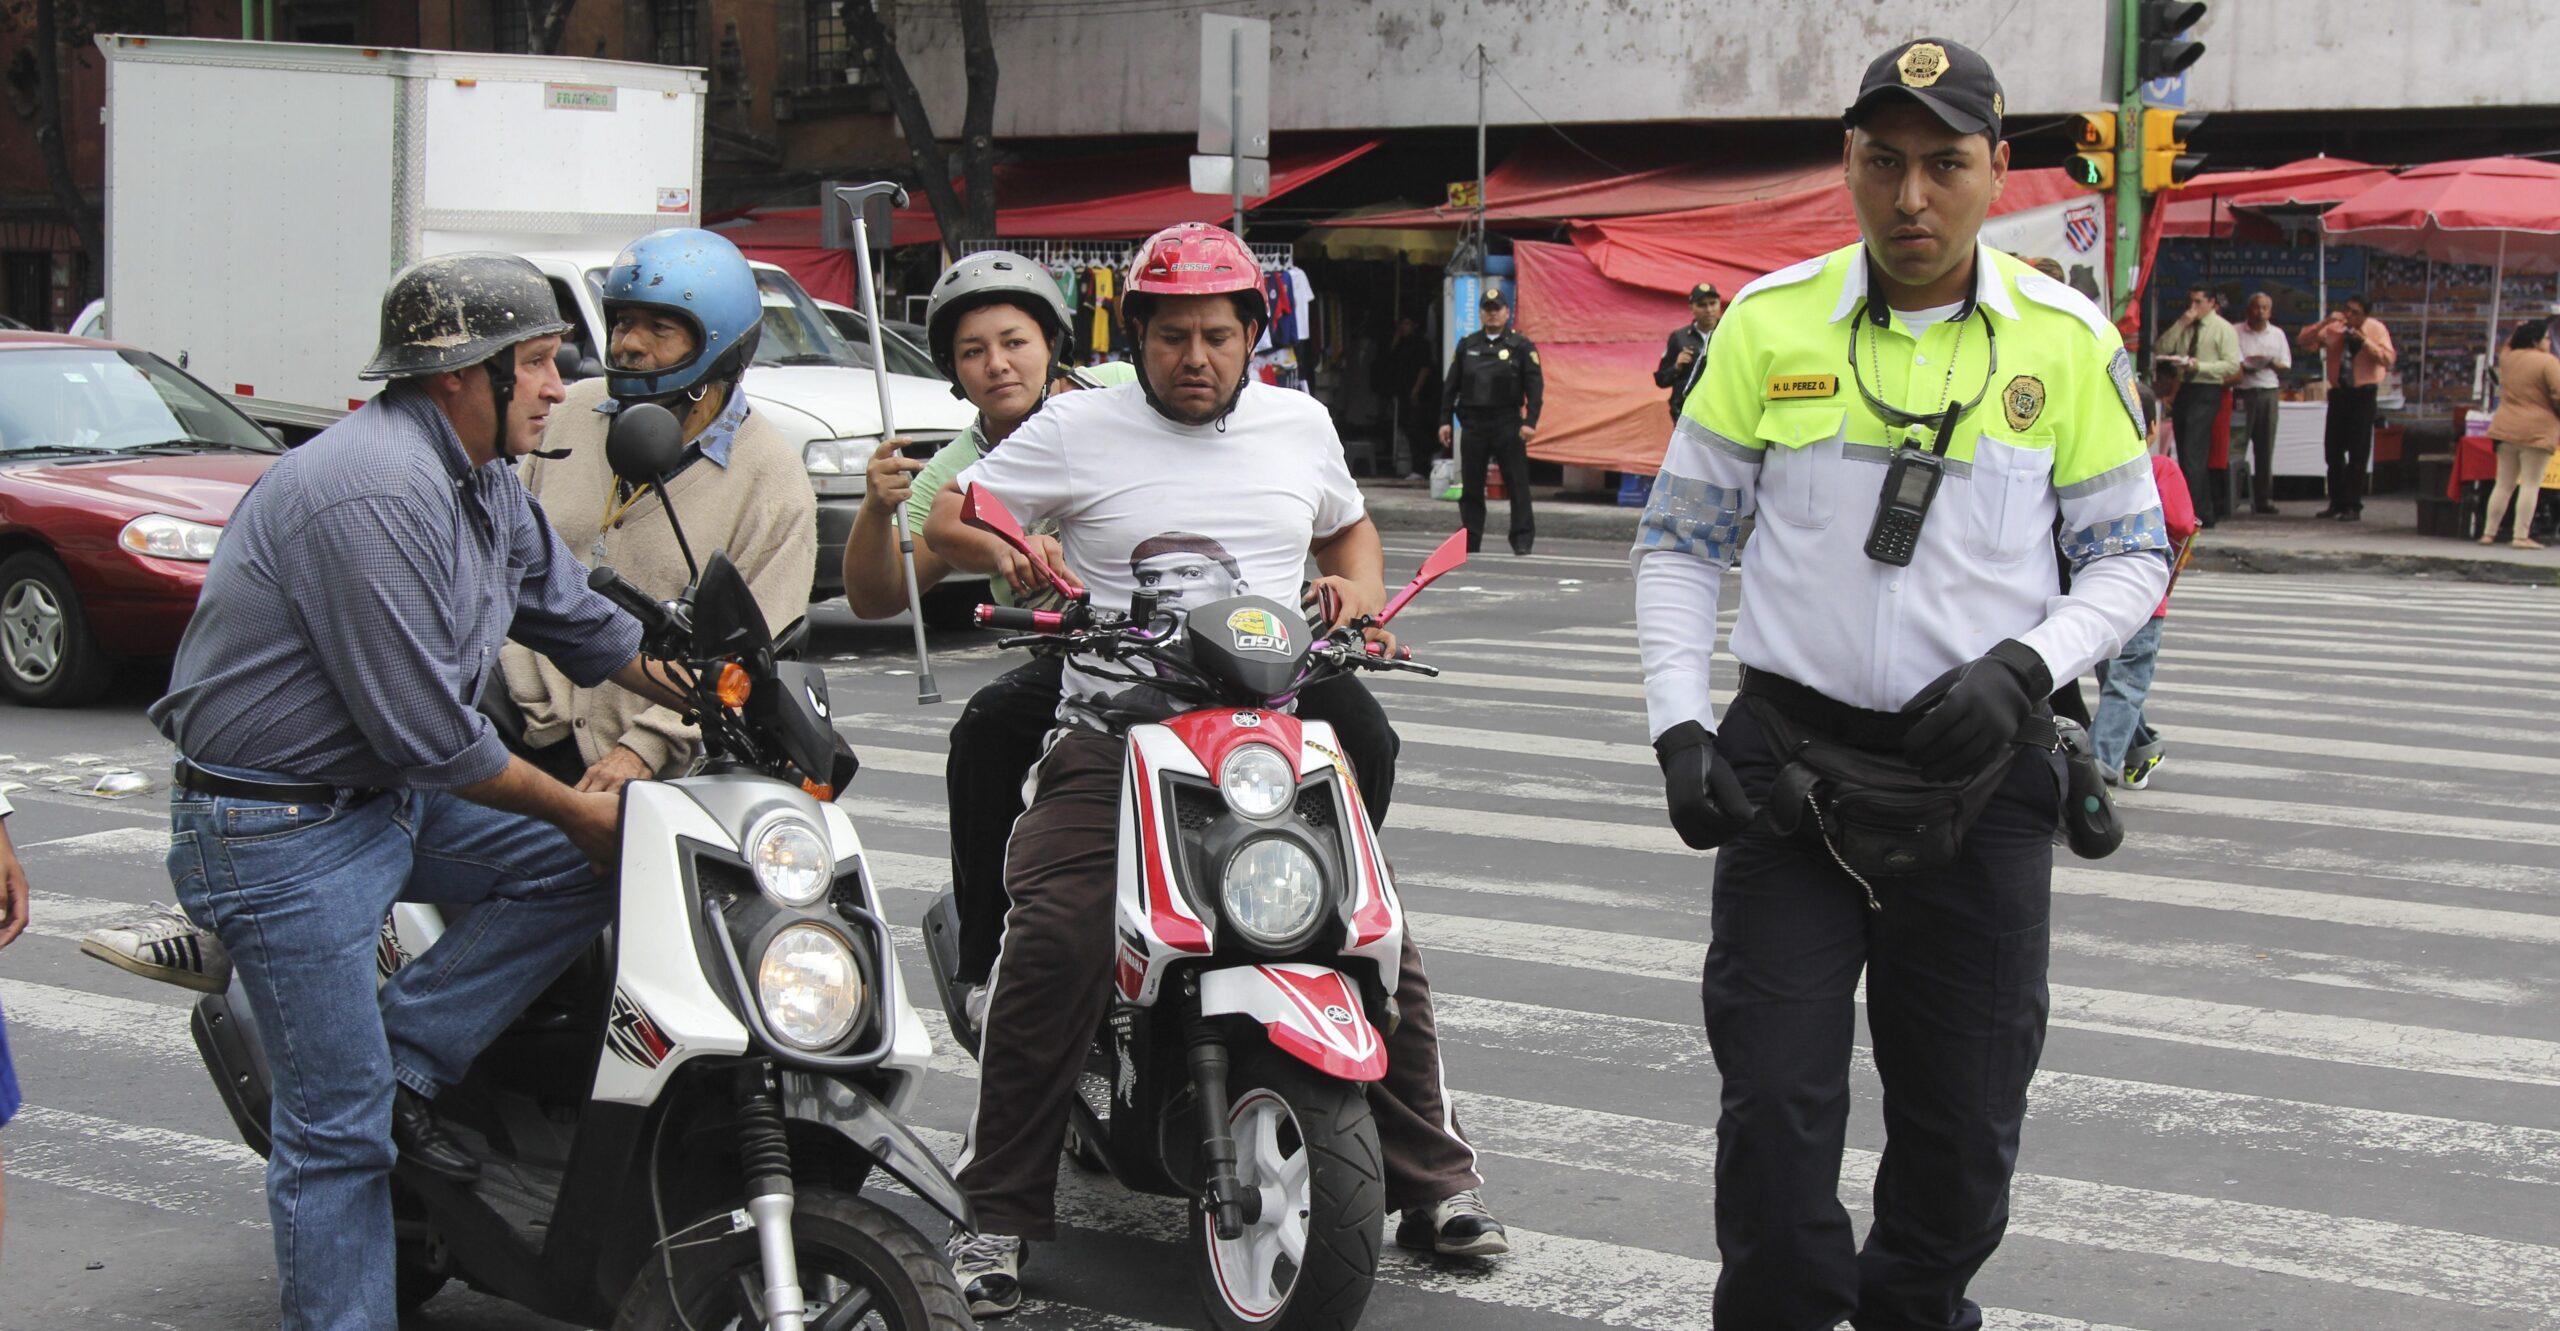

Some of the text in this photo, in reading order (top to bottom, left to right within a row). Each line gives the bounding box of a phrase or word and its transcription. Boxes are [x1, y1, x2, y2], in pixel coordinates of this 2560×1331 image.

[1773, 381, 1827, 392] H. U. PEREZ O.
